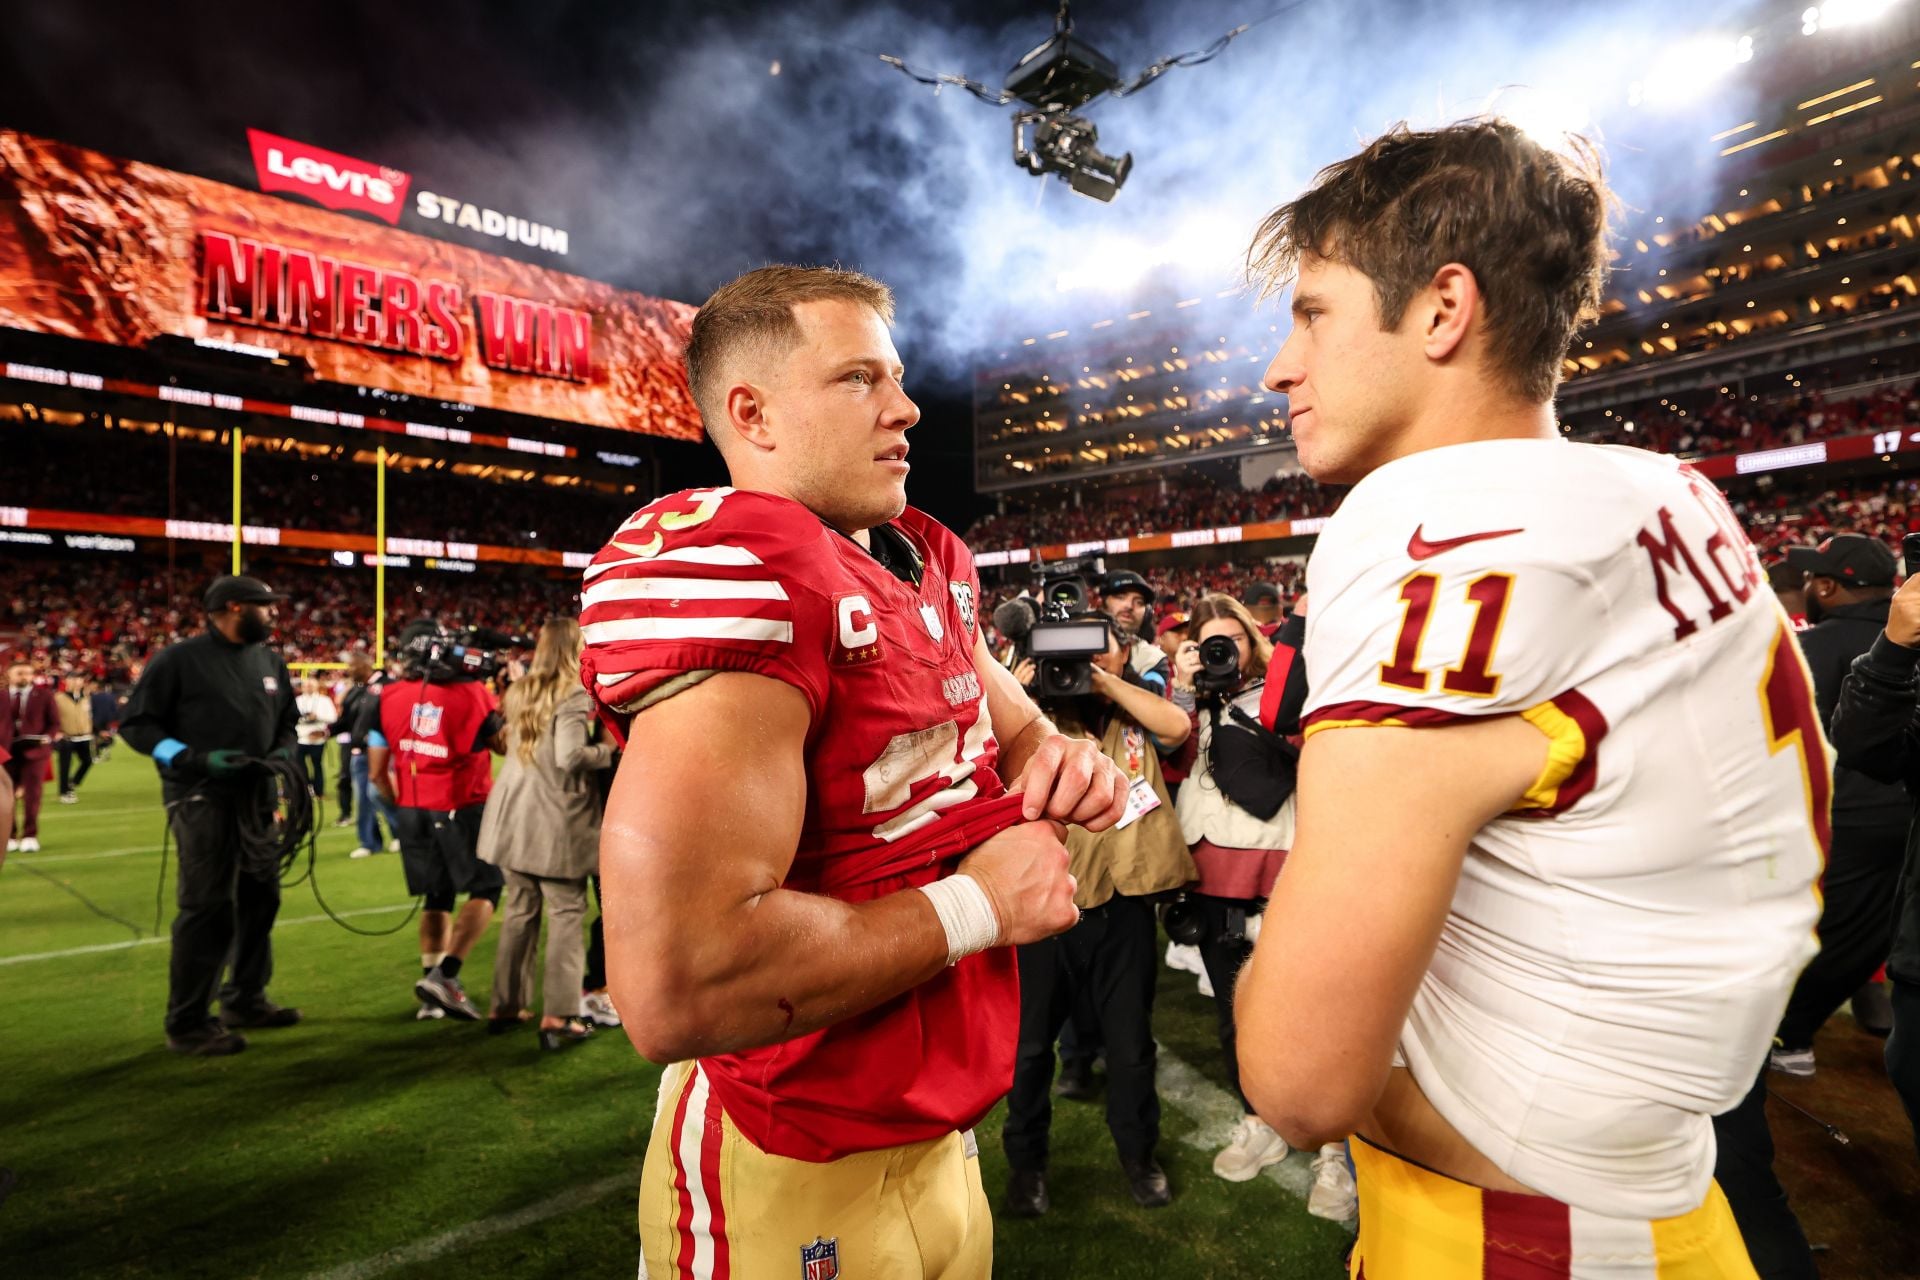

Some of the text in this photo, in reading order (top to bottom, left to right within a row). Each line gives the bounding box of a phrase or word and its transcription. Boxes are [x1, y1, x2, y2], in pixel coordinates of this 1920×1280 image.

[416, 190, 568, 255] STADIUM
[202, 230, 592, 383] NINERS WIN
[1873, 431, 1902, 454] 17
[838, 595, 878, 649] C
[1378, 571, 1517, 699] 11
